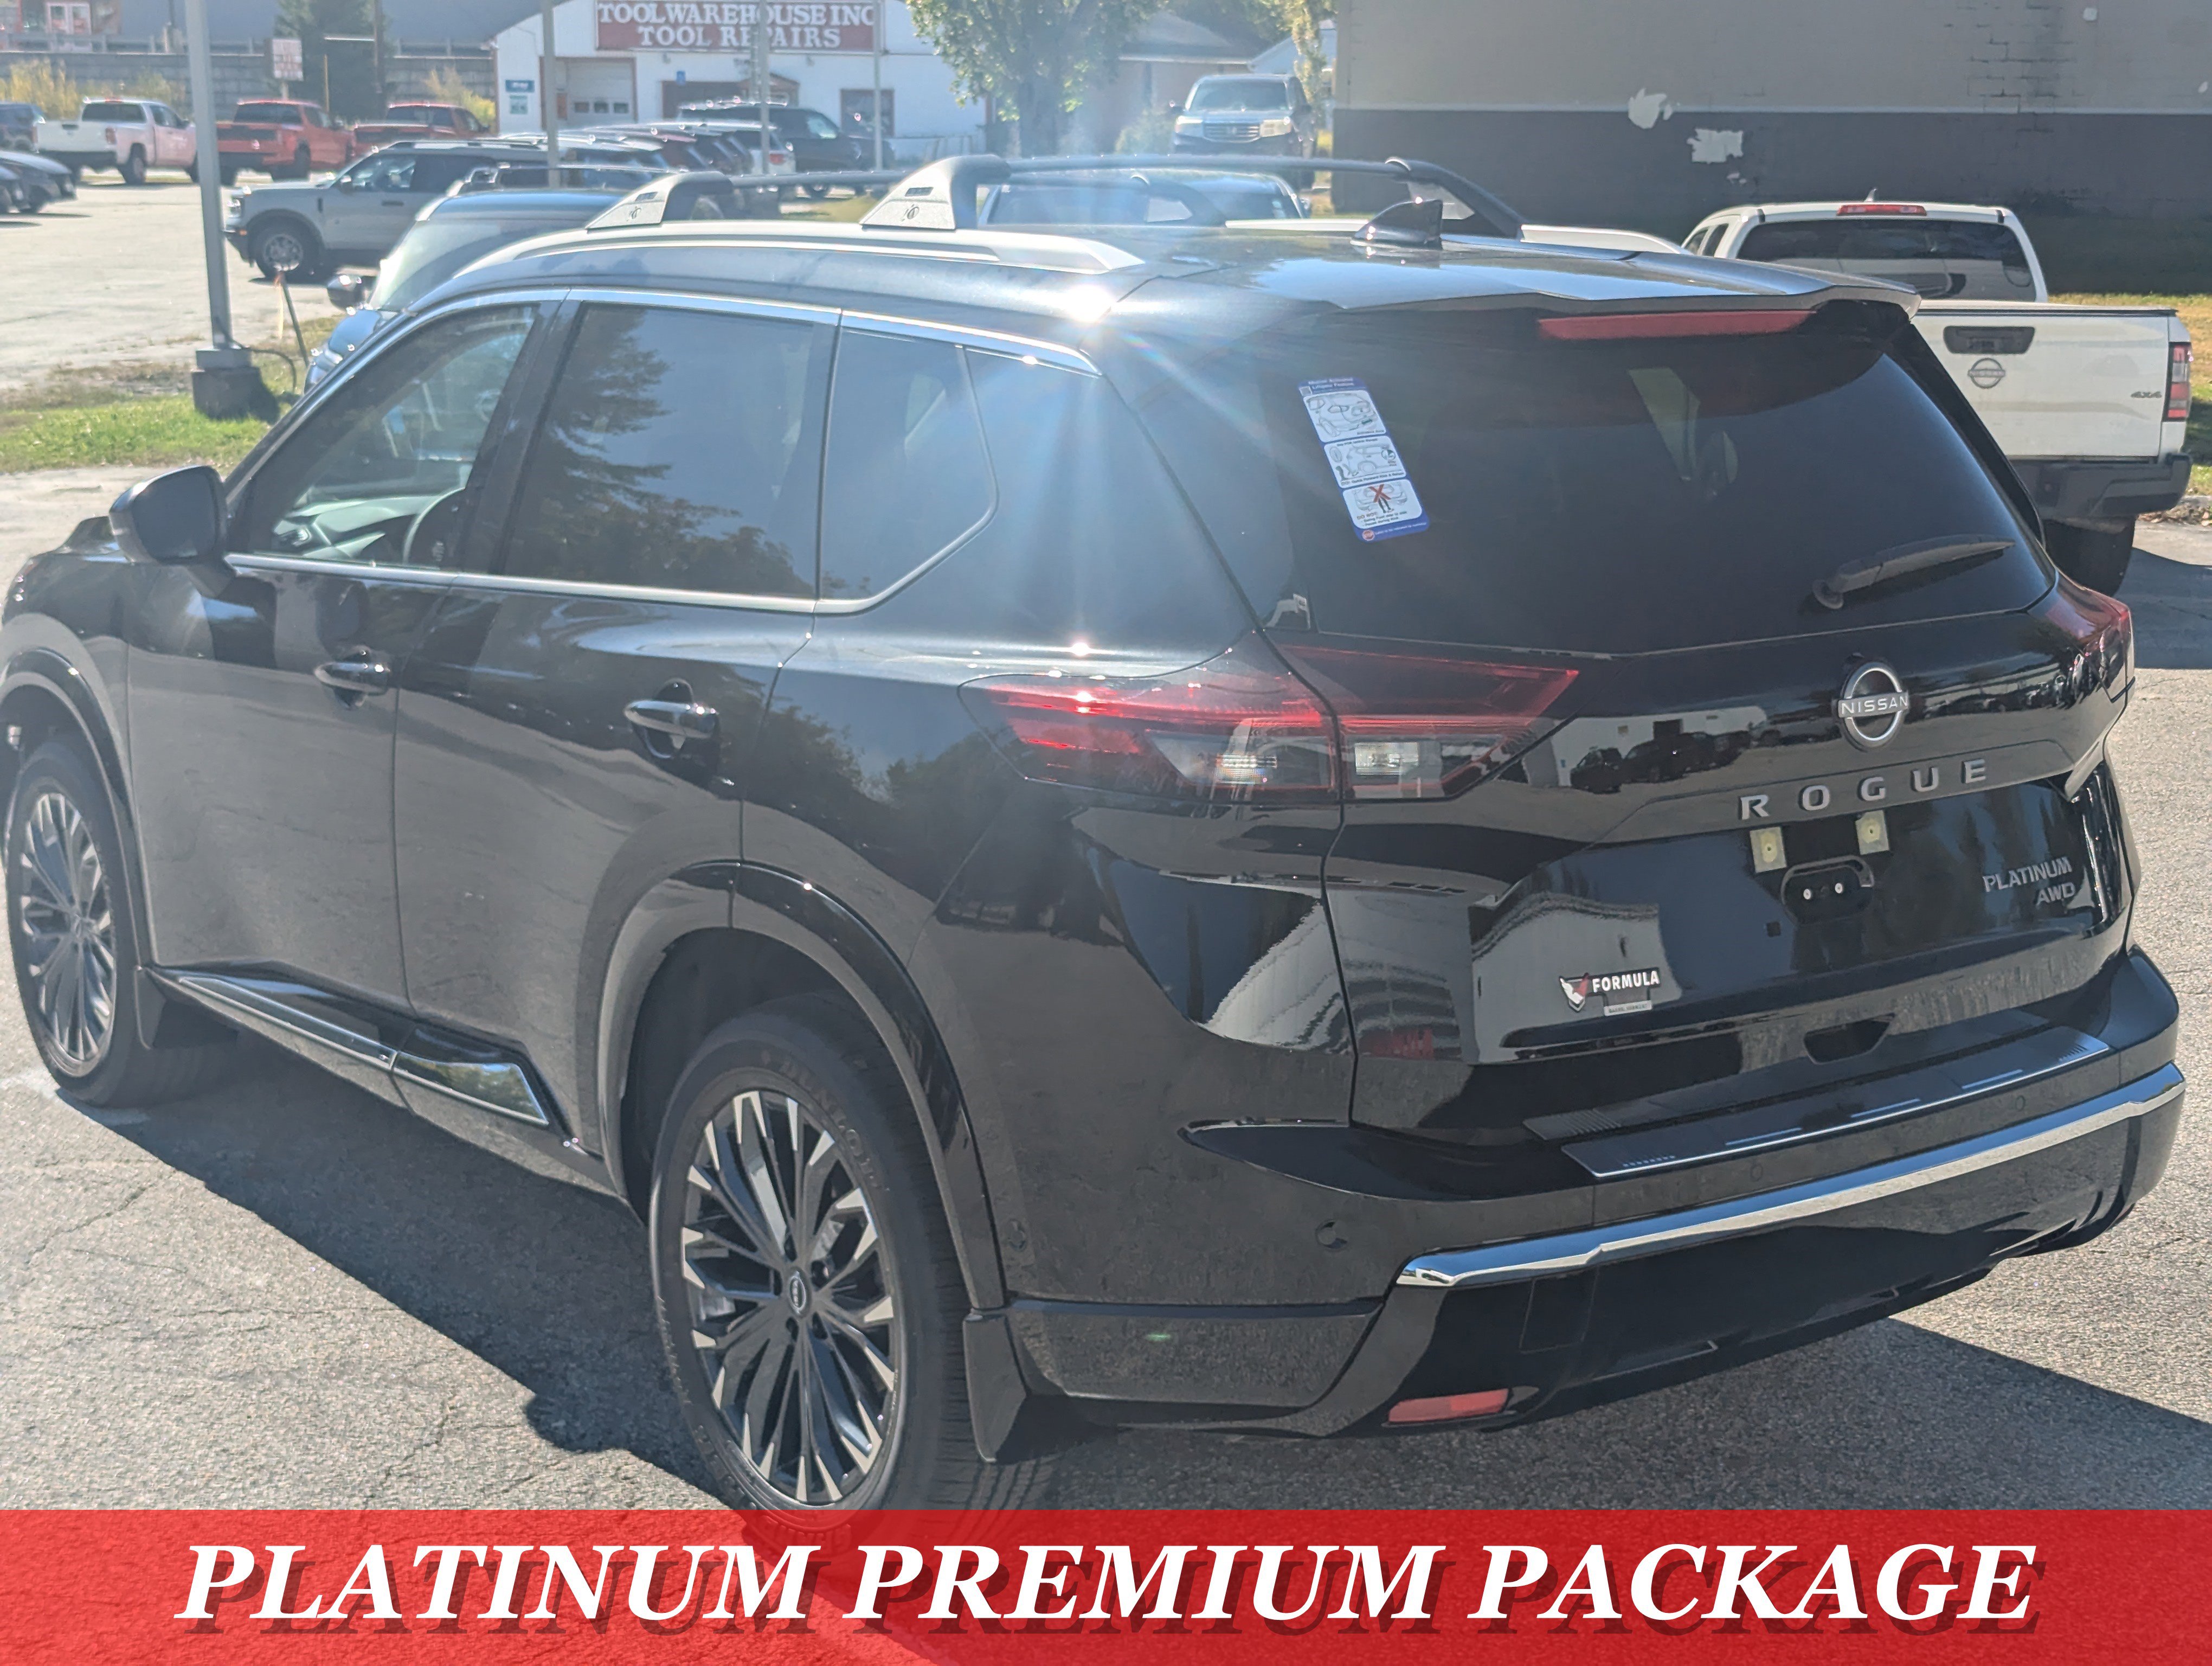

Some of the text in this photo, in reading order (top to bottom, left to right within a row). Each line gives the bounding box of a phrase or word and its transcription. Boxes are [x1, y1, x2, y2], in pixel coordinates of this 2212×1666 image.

[638, 25, 712, 47] TOOL
[1841, 696, 1908, 715] NISSAN
[1739, 759, 1986, 820] ROGUE
[1982, 856, 2073, 892] PLATINUM
[2036, 882, 2076, 909] AWD
[1592, 970, 1661, 993] FORMULA
